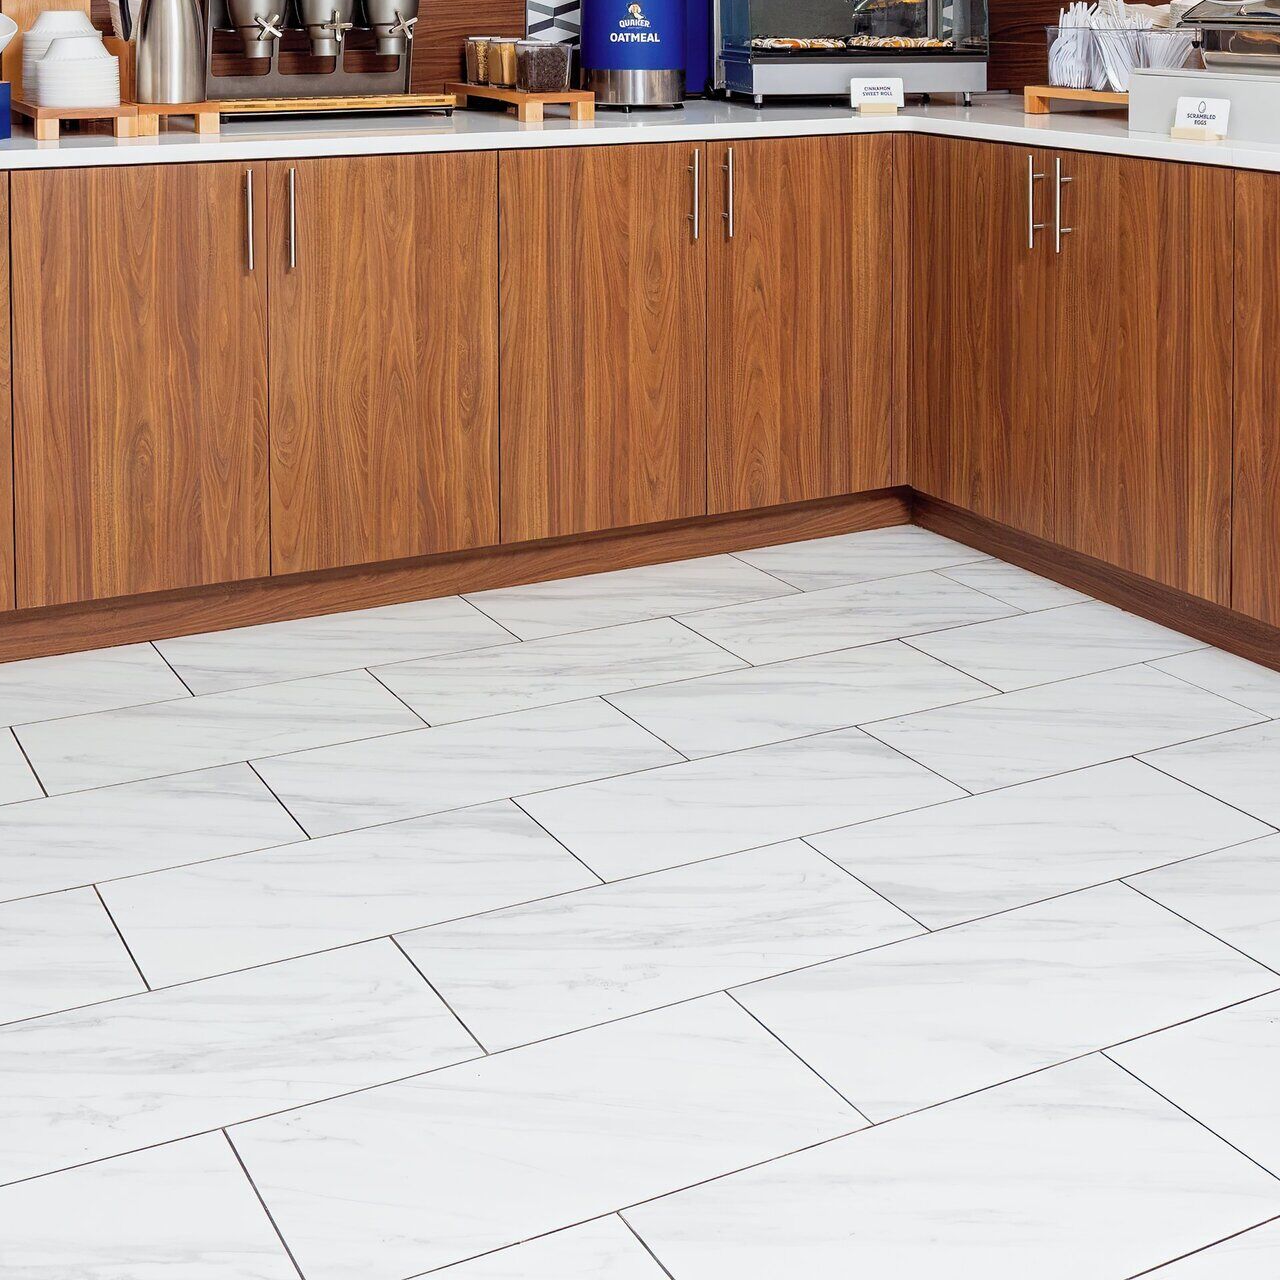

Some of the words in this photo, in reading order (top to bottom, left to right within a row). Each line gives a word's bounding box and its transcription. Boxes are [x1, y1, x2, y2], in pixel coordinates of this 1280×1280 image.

[618, 19, 652, 28] QUAKER
[609, 32, 661, 43] OATMEAL
[1186, 112, 1217, 120] SCRAMBLED
